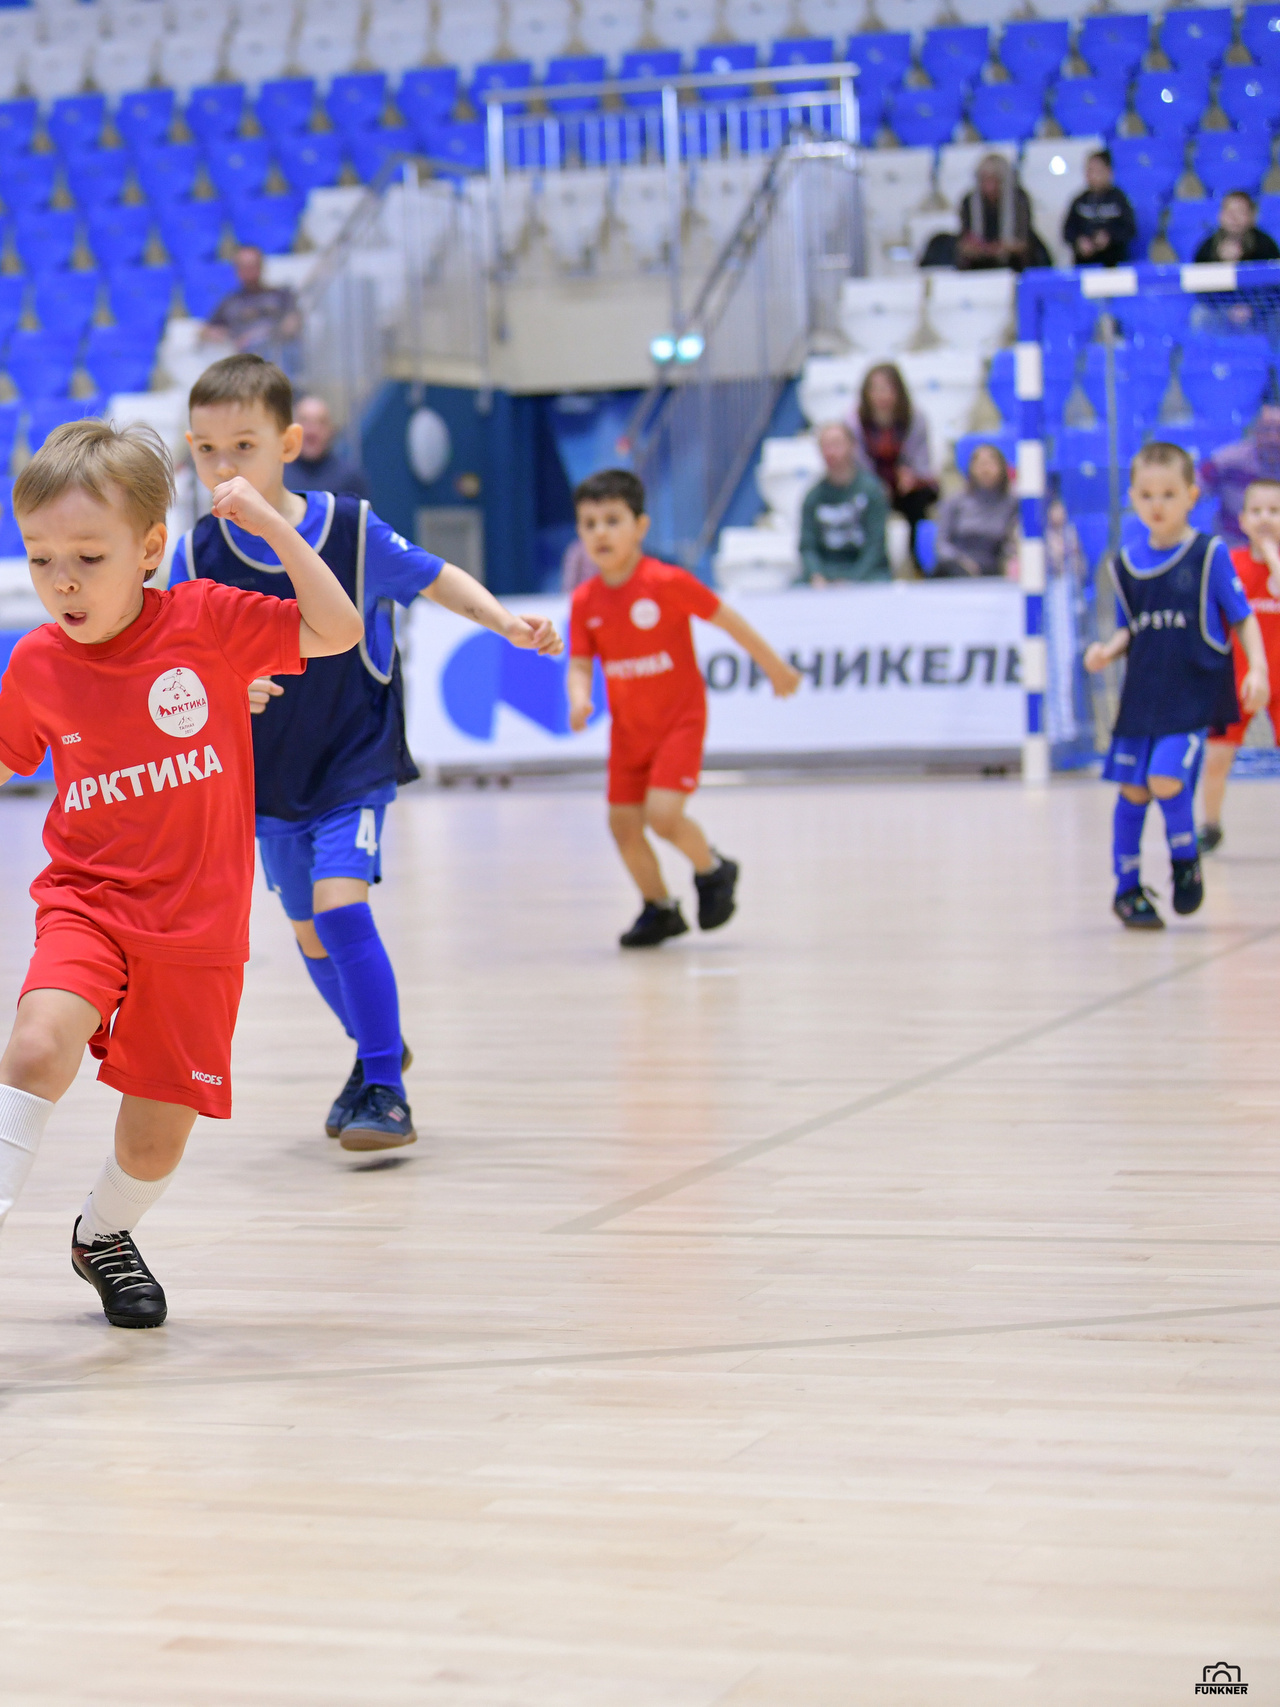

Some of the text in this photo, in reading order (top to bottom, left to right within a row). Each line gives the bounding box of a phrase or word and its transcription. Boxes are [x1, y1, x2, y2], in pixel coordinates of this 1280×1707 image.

[64, 744, 223, 813] АРКТИКА
[355, 808, 378, 856] 4
[192, 1070, 223, 1086] KODES
